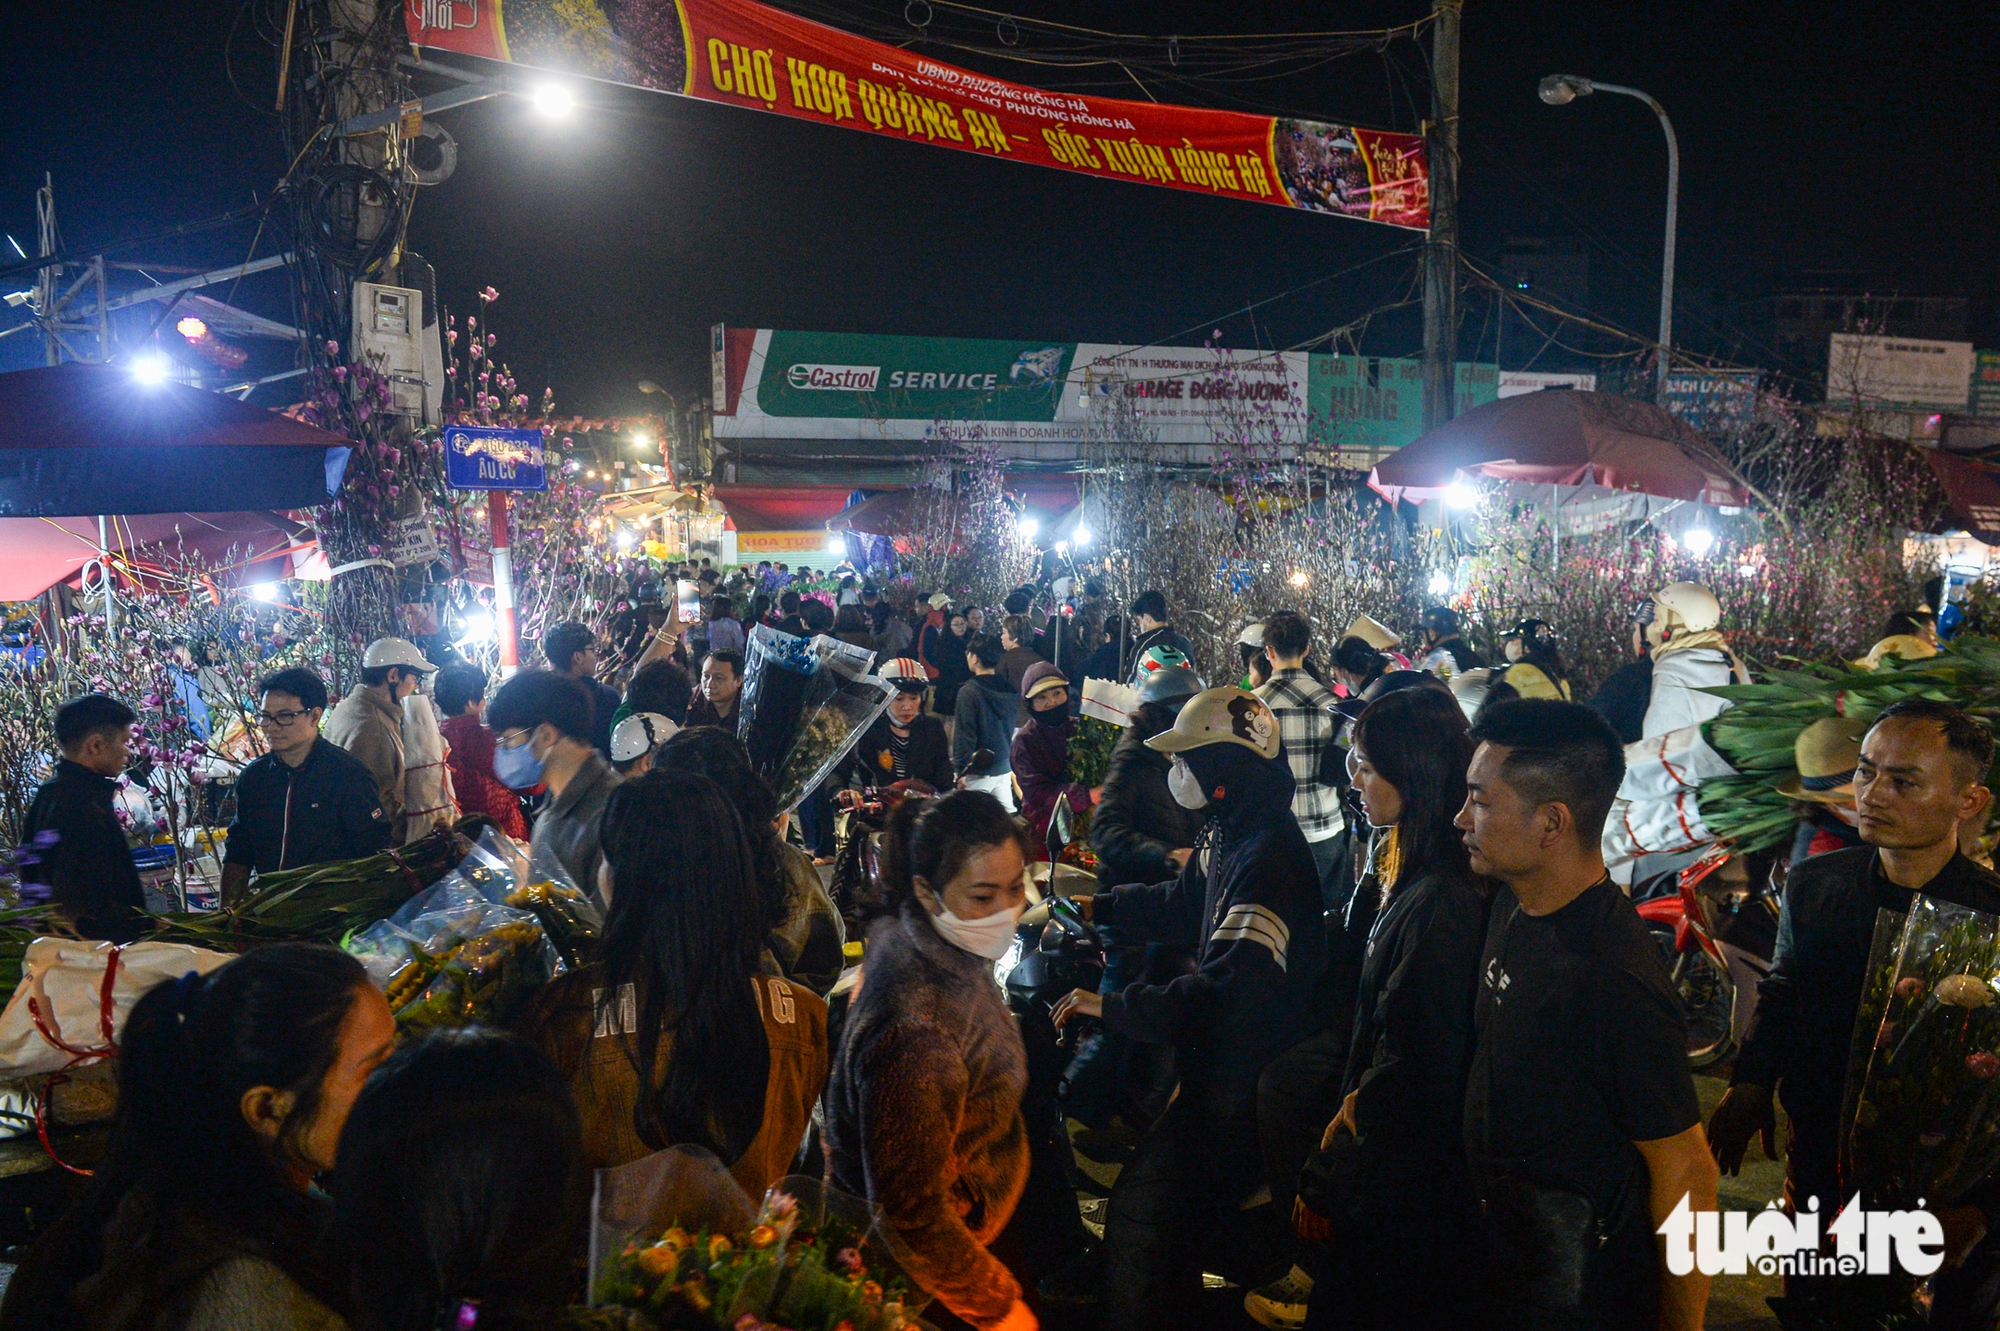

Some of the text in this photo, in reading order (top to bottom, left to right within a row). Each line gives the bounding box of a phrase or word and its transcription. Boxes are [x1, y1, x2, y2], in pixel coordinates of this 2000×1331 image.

[916, 61, 960, 84] UBND
[1067, 98, 1089, 112] HÀ
[707, 37, 777, 110] CHỢ
[786, 56, 854, 121] HOA
[858, 78, 964, 143] QUẢNG
[962, 108, 1012, 154] AN
[1041, 122, 1101, 170] SẮC
[1093, 136, 1177, 184] XUÂN
[1169, 137, 1240, 192] HỒNG
[1234, 149, 1273, 198] HÀ
[1006, 101, 1069, 123] PHƯỜNG
[1071, 110, 1112, 128] HỒNG
[1113, 117, 1136, 132] HÀ
[808, 366, 998, 391] Castrol SERVICE
[1123, 380, 1184, 399] GARAGE
[1238, 379, 1289, 402] DƯƠNG
[990, 427, 1018, 438] KINH
[1020, 427, 1060, 438] DOANH
[1062, 427, 1085, 439] HOA
[479, 457, 496, 479] ÂU
[747, 537, 779, 547] HOA
